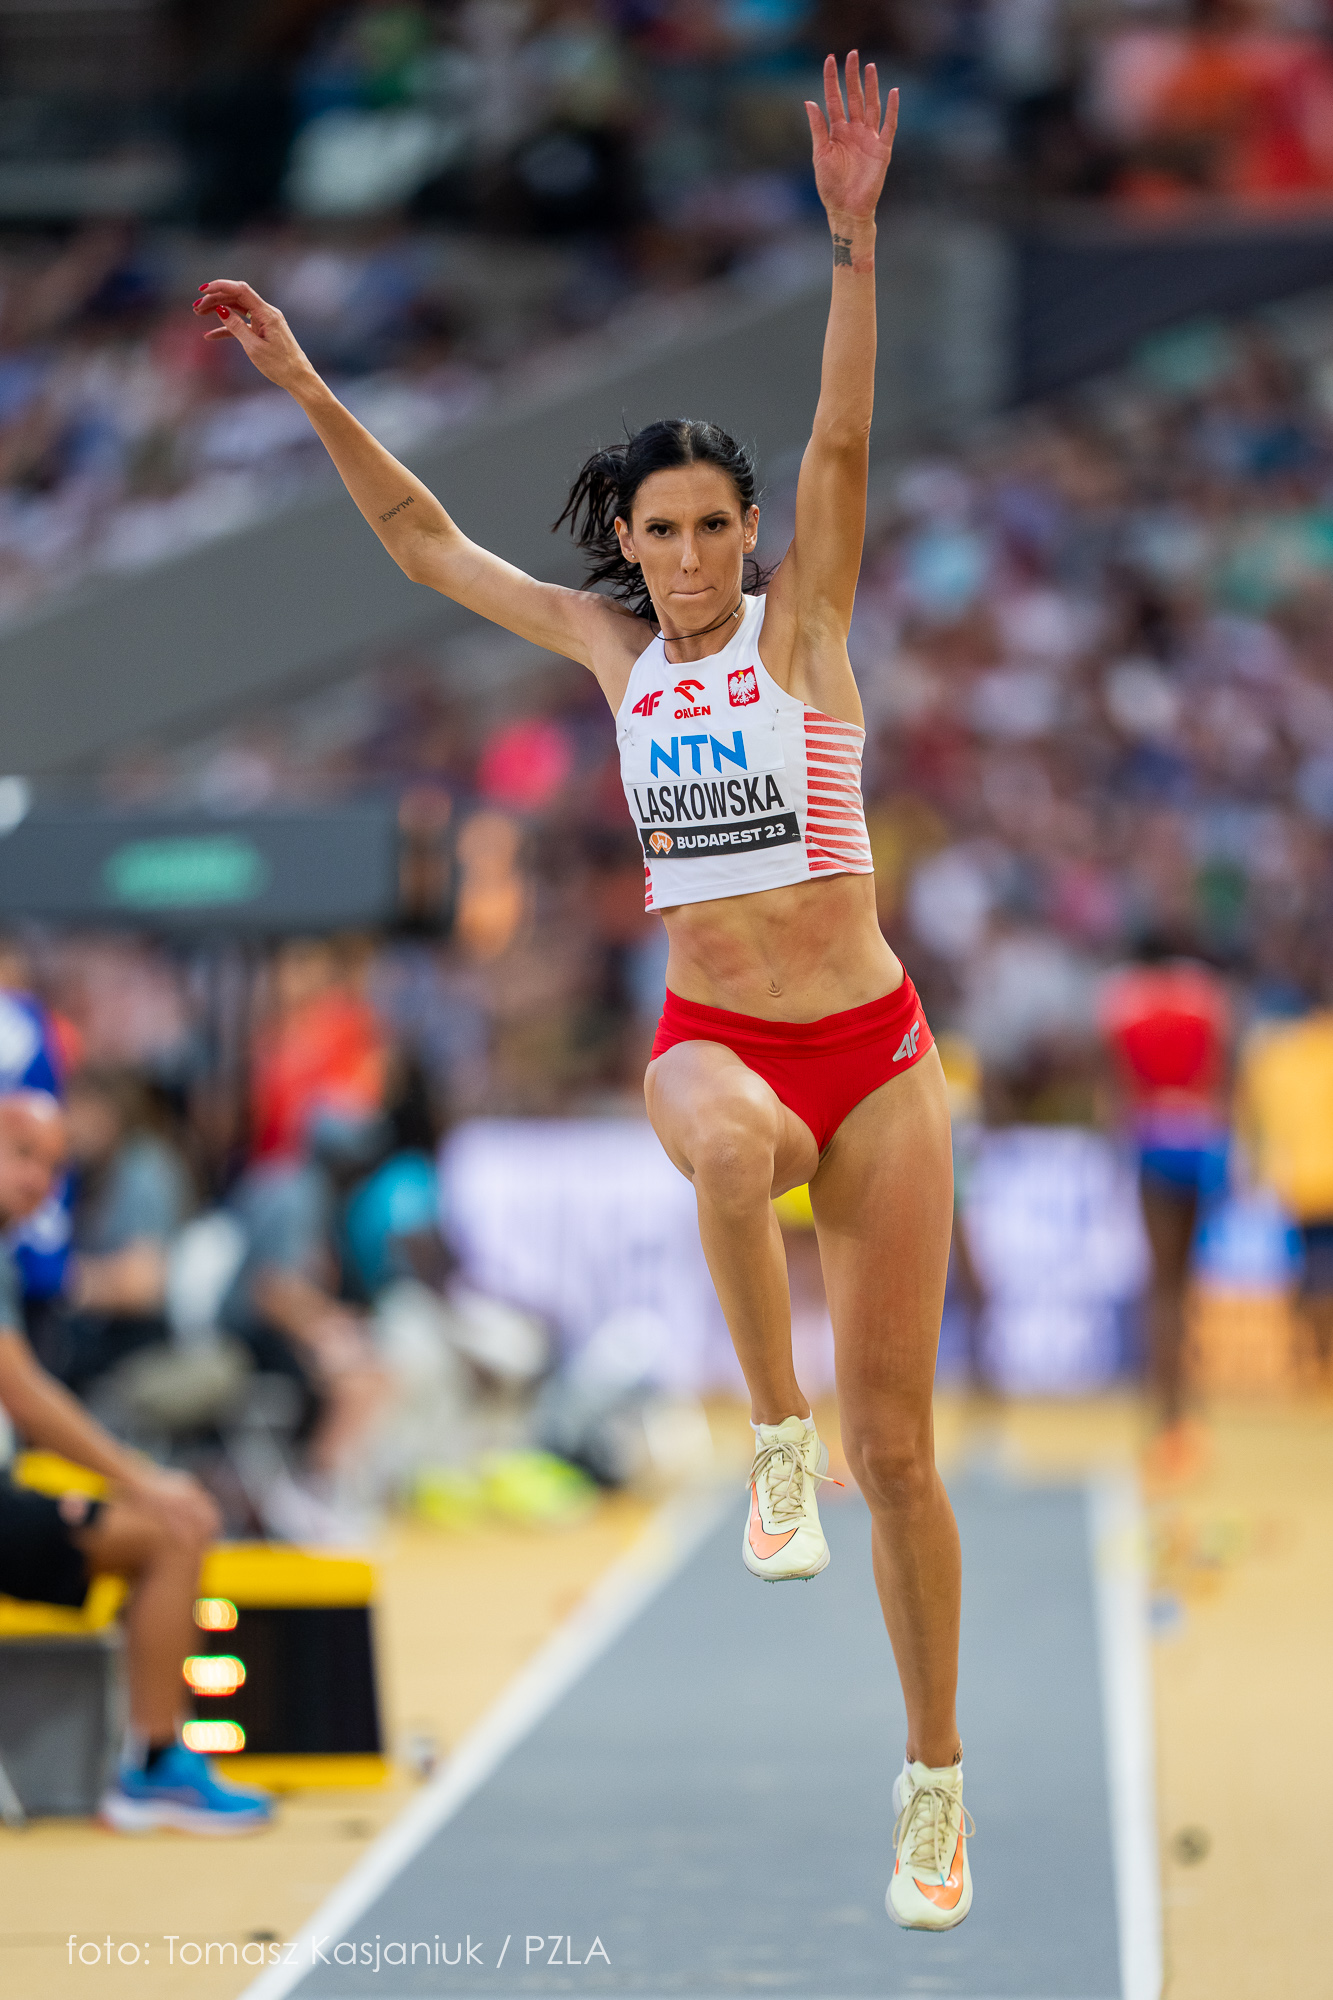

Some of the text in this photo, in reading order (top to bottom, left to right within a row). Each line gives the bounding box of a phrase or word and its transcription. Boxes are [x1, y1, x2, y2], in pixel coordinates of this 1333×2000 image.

[379, 496, 415, 522] BALANCE
[632, 690, 664, 717] 4F
[674, 705, 711, 720] ORLEN
[650, 730, 748, 779] NTN
[634, 774, 785, 823] LASKOWSKA
[676, 823, 786, 850] BUDAPEST 23
[892, 1020, 920, 1062] 4F
